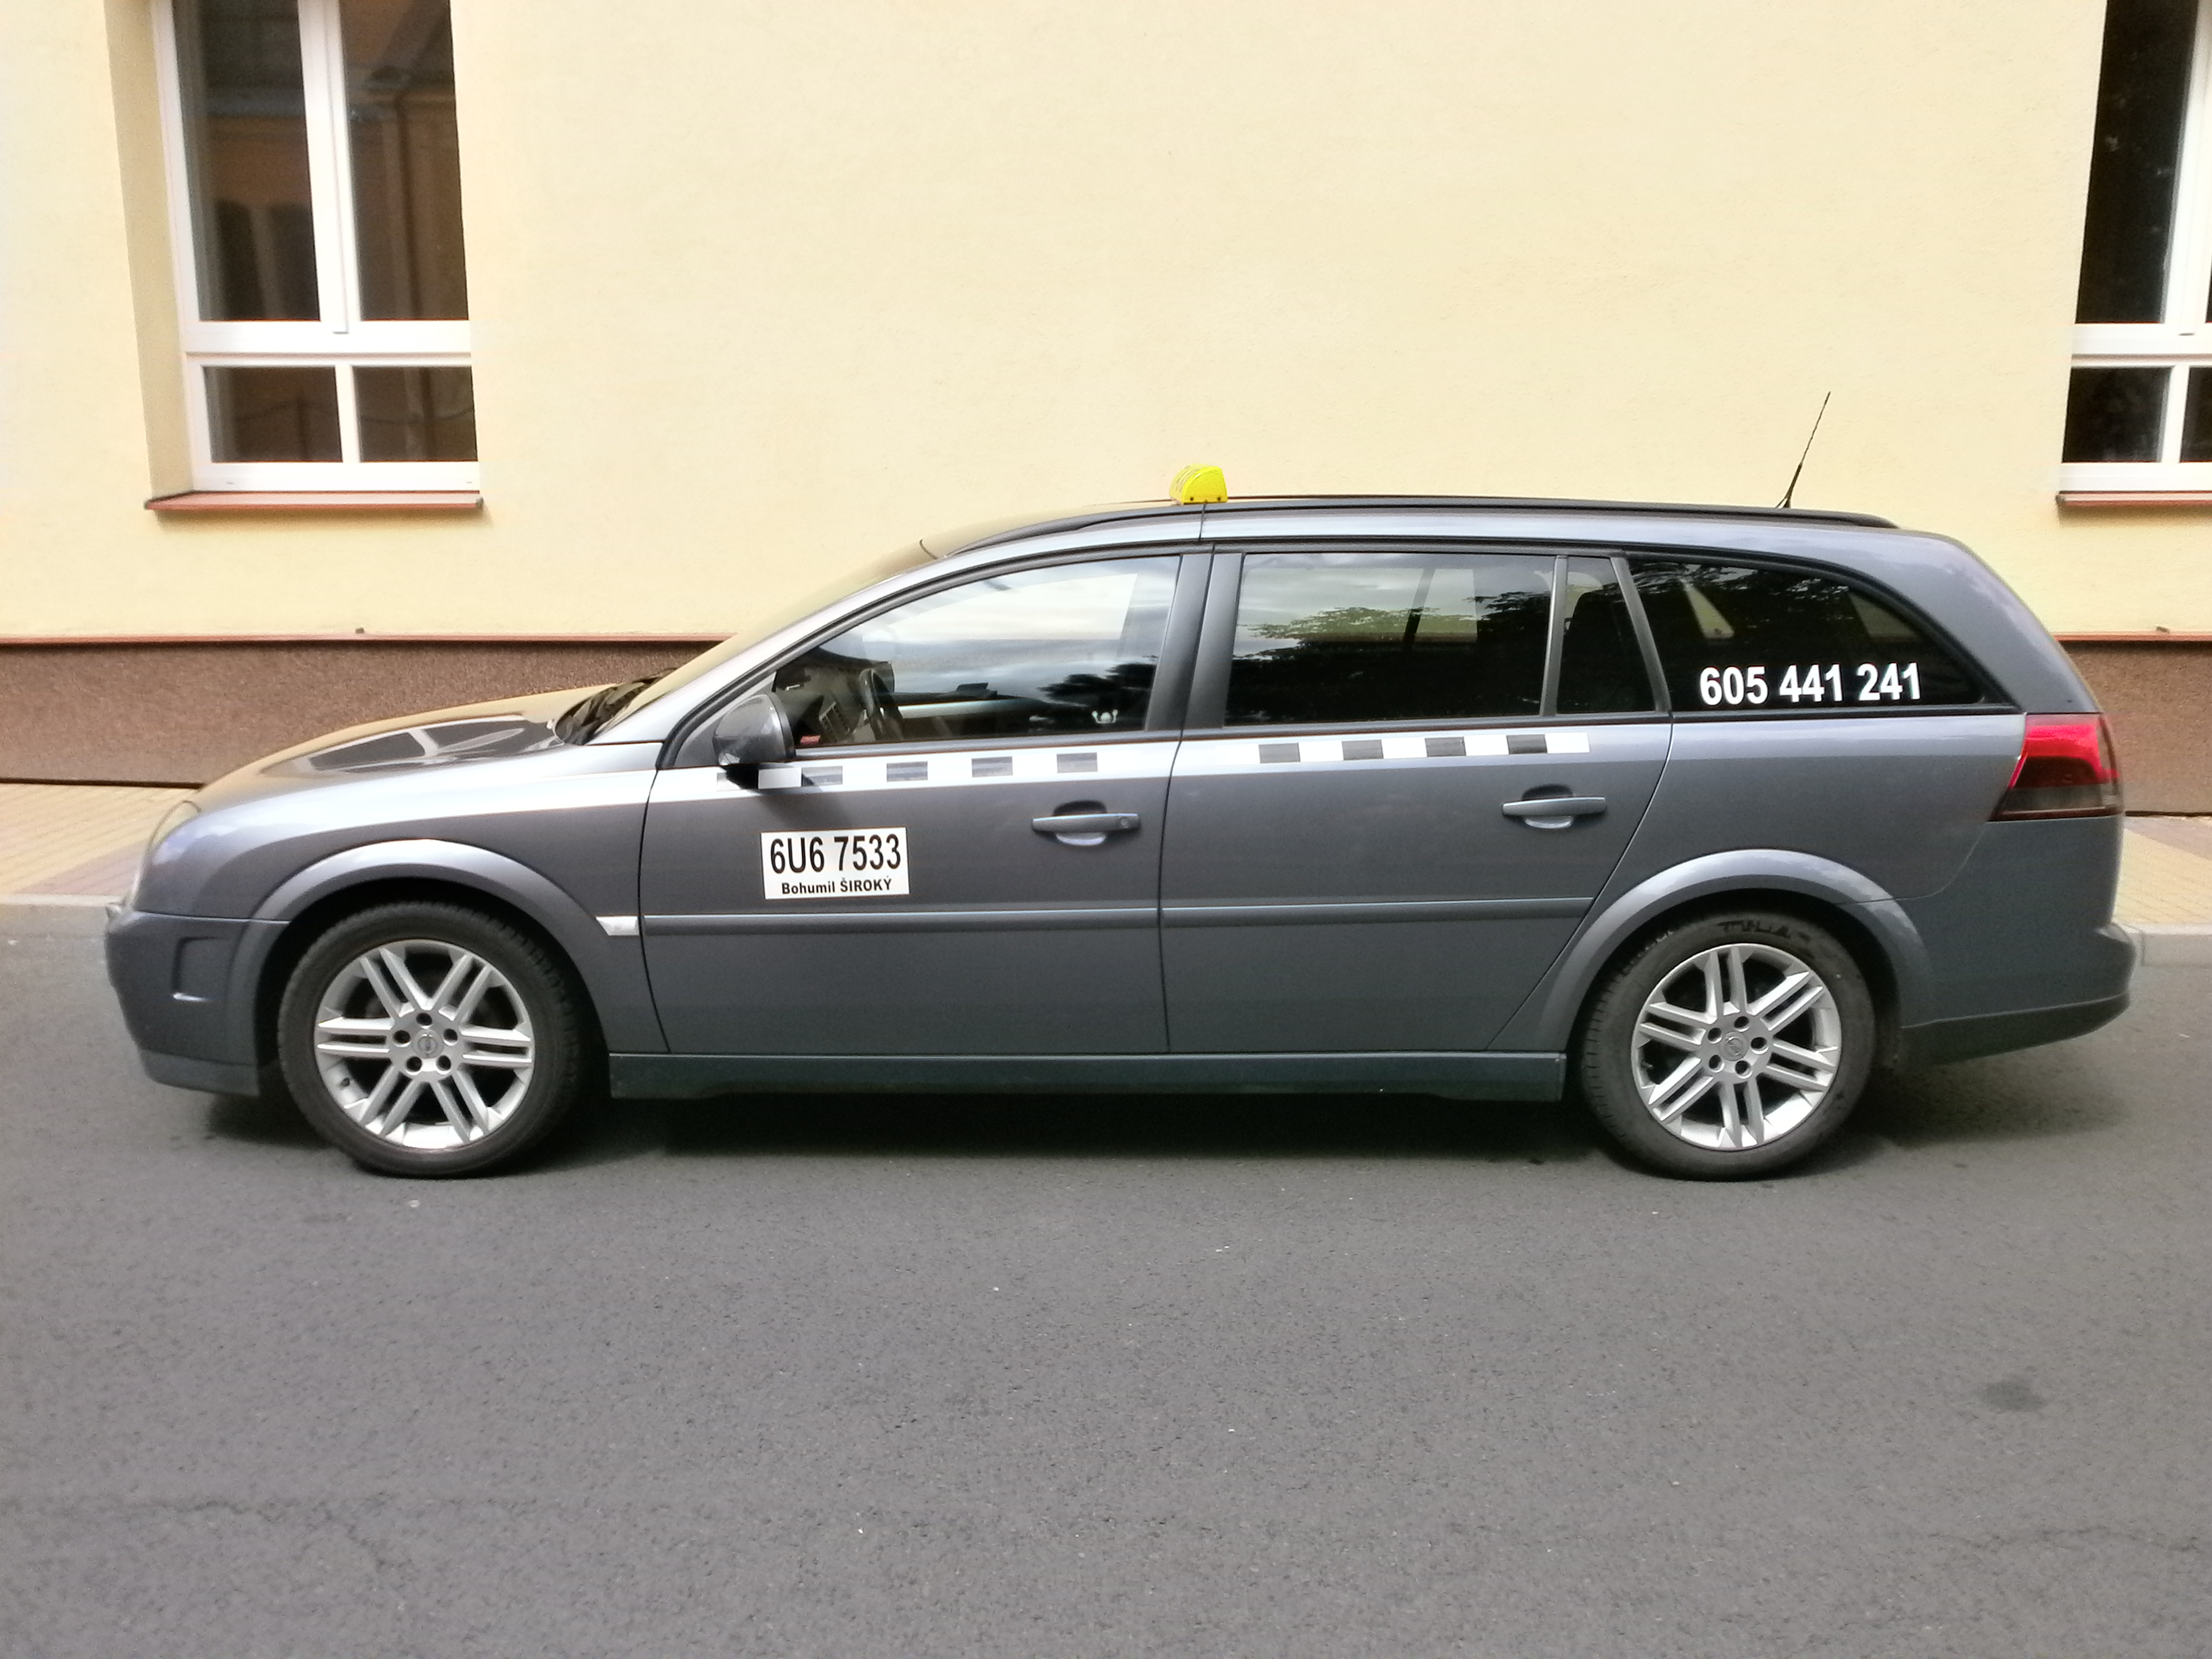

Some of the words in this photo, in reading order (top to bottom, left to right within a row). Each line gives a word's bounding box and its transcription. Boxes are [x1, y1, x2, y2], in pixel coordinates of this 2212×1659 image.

[1700, 666, 1768, 706] 605
[1779, 663, 1843, 702] 441
[1857, 662, 1920, 701] 241
[770, 836, 824, 874] 6U6
[834, 833, 901, 871] 7533
[782, 881, 836, 894] Bohumil
[840, 876, 892, 892] ŠIROKÝ
